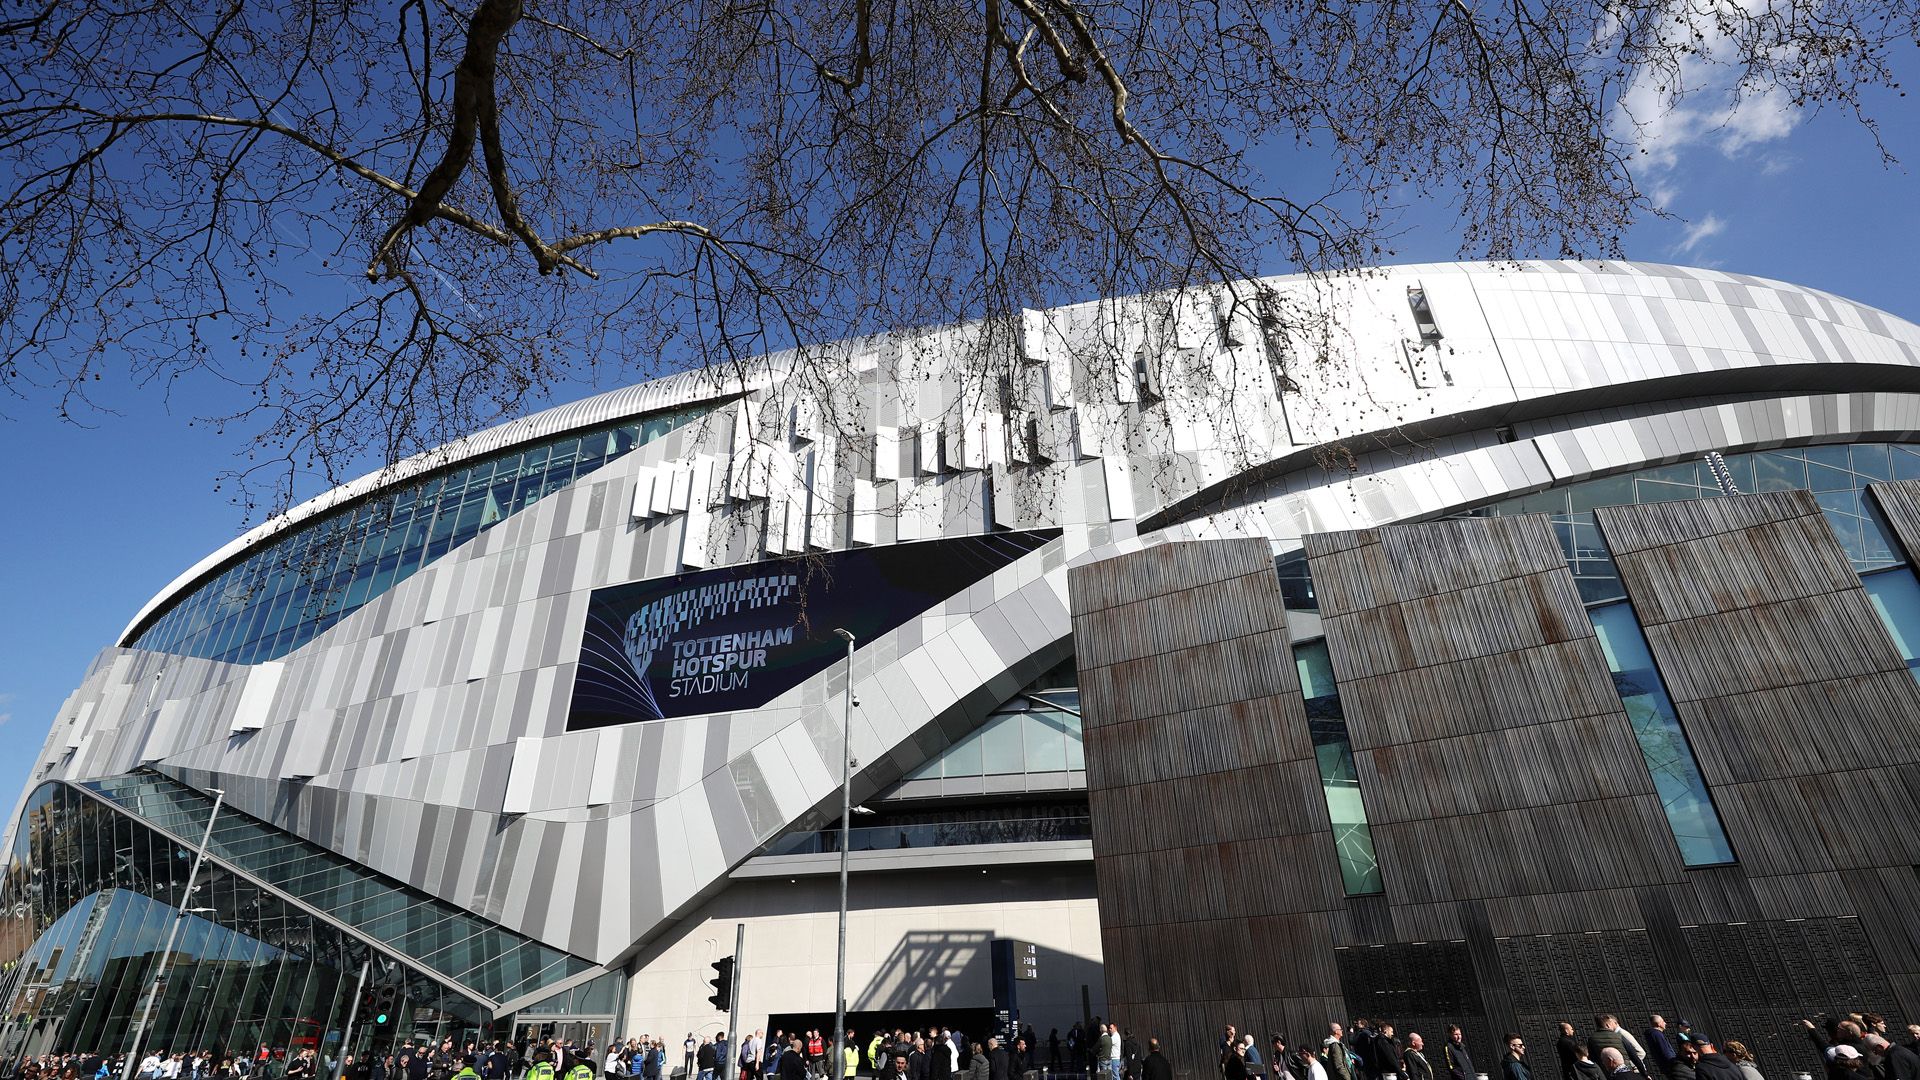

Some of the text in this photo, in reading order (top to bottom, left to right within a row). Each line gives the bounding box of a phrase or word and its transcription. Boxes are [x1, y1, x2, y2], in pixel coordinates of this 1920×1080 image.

[672, 627, 793, 659] TOTTENHAM
[672, 649, 767, 678] HOTSPUR
[669, 670, 748, 698] STADIUM
[146, 1060, 156, 1068] 24
